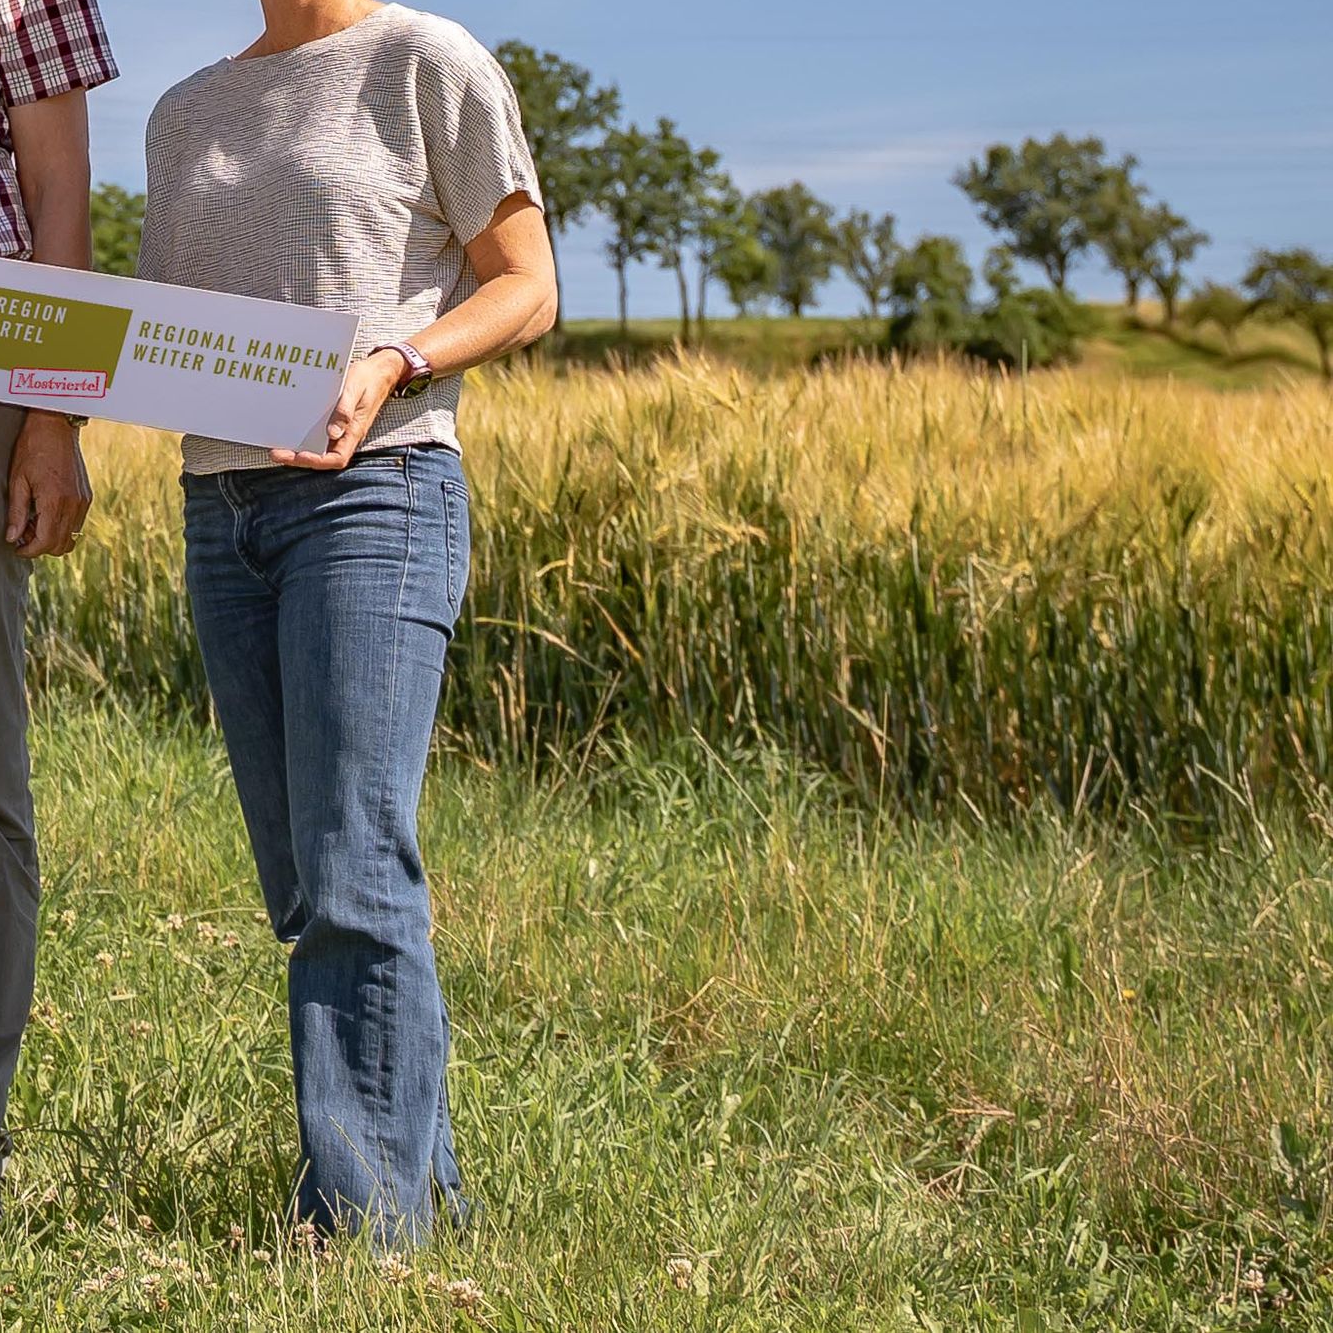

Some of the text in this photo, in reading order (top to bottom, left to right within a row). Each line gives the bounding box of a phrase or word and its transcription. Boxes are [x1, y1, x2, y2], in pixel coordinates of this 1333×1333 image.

[133, 343, 296, 388] WEITER DENKEN.
[138, 321, 344, 374] REGIONAL HANDELN,
[15, 372, 100, 392] Mostviertel
